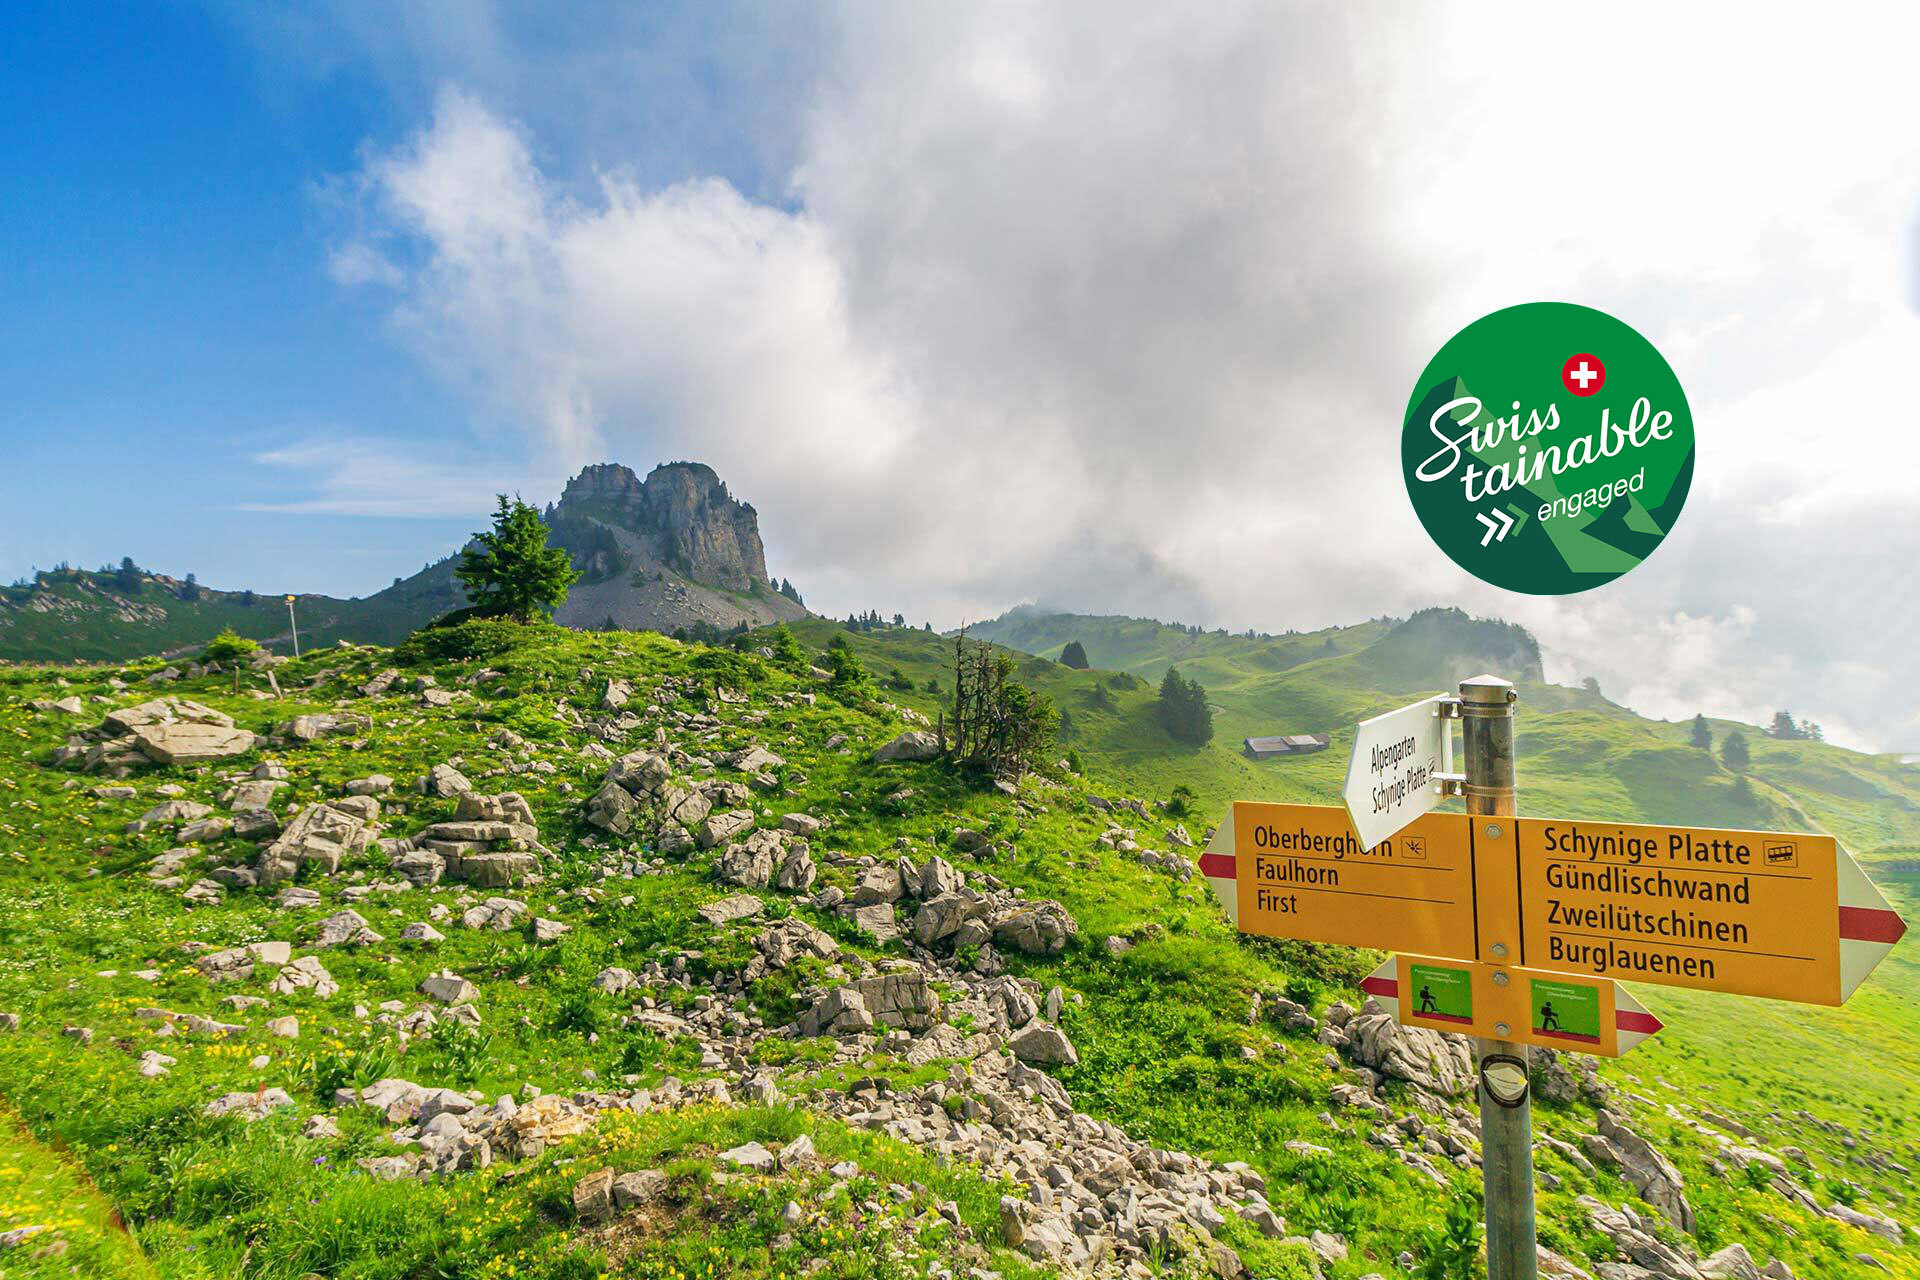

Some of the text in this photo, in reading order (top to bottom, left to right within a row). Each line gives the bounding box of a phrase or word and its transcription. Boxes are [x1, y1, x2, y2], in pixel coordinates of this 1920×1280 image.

[1370, 736, 1416, 778] Alpengarten
[1372, 765, 1427, 814] Schynige Platte
[1544, 826, 1751, 865] Schynige Platte
[1256, 857, 1339, 886] Faulhorn
[1546, 863, 1750, 905] Gündlischwand
[1257, 889, 1298, 914] First
[1546, 900, 1749, 944] Zweilütschinen
[1549, 936, 1716, 979] Burglauenen
